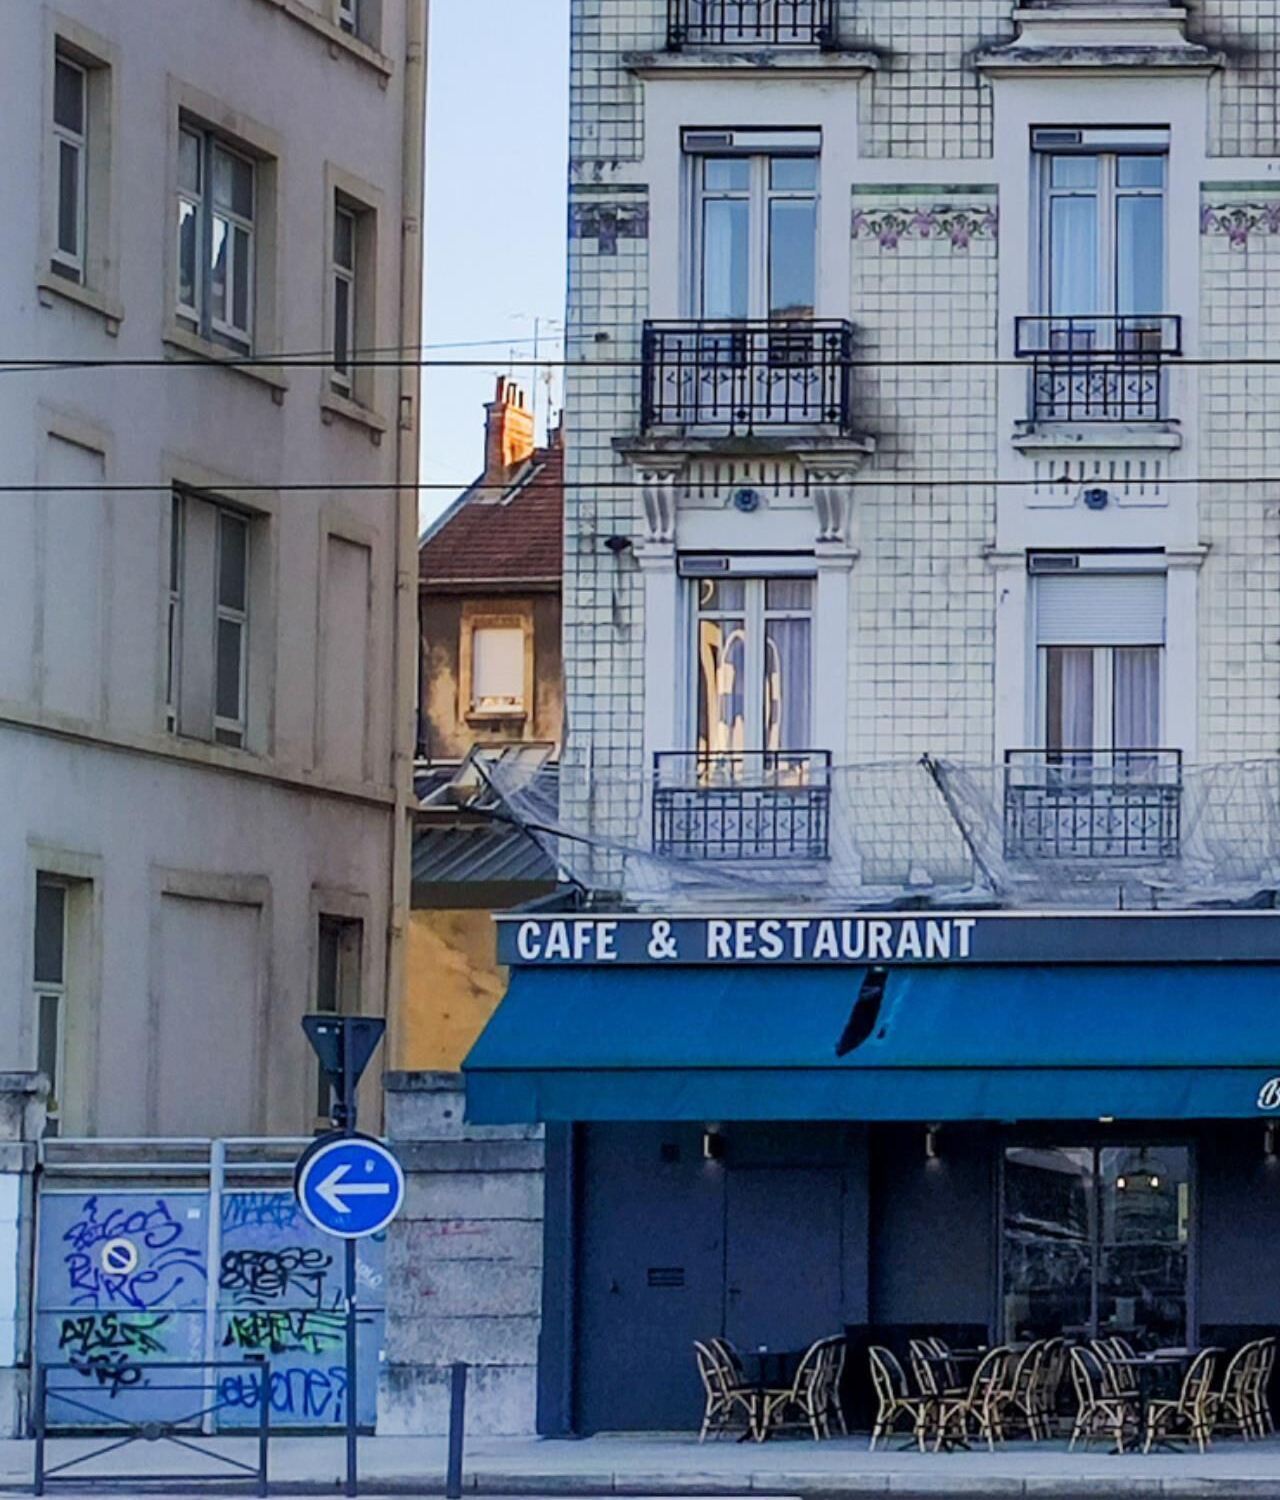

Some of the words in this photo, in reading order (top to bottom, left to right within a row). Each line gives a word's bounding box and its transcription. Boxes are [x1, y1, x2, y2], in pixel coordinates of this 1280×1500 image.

[517, 920, 618, 960] CAFE
[647, 920, 678, 959] &
[706, 918, 976, 958] RESTAURANT
